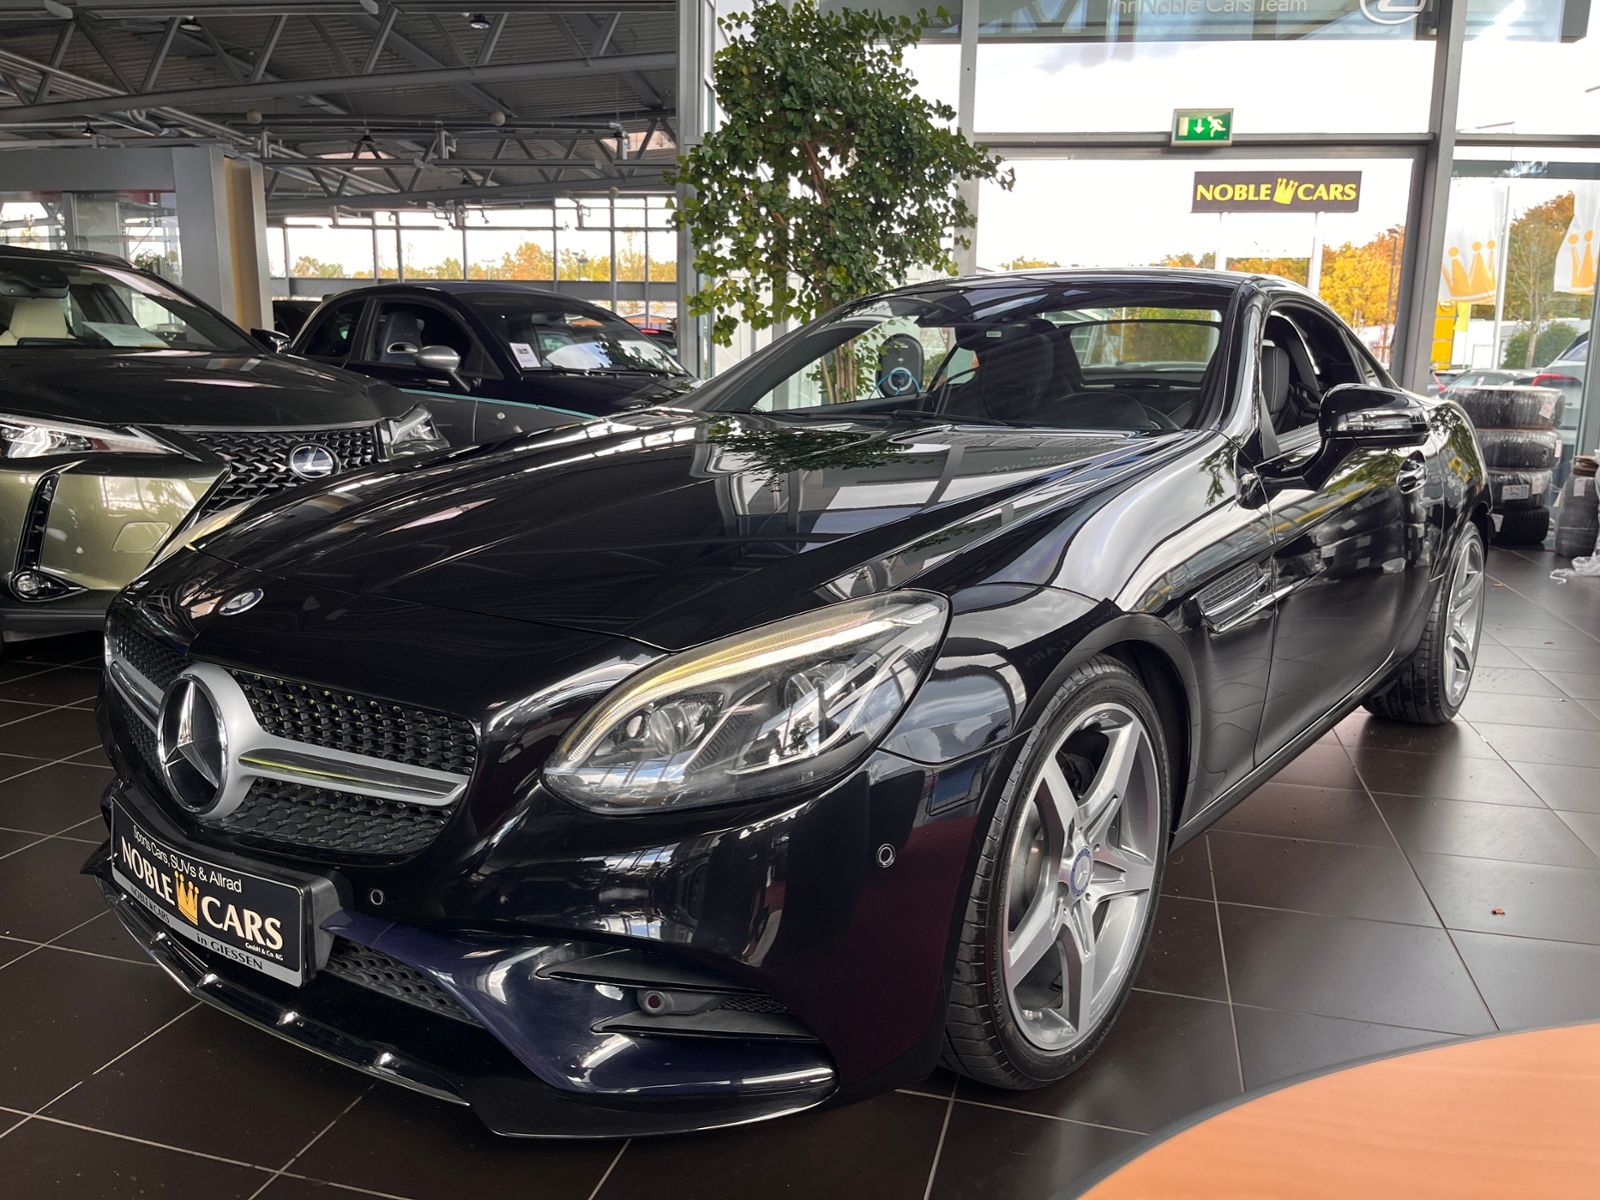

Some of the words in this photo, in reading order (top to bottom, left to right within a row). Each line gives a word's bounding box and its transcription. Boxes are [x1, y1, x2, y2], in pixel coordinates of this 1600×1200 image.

[1206, 0, 1251, 13] Cars
[1260, 0, 1307, 12] Team
[1196, 184, 1272, 201] NOBLE
[1297, 183, 1357, 201] CARS
[151, 842, 171, 868] Cars,
[170, 854, 197, 878] SUVs
[198, 866, 208, 882] &
[209, 871, 243, 893] Allrad
[121, 835, 176, 906] NOBLE
[201, 895, 284, 950] CARS
[196, 932, 208, 946] in
[210, 940, 264, 971] GIESSEN
